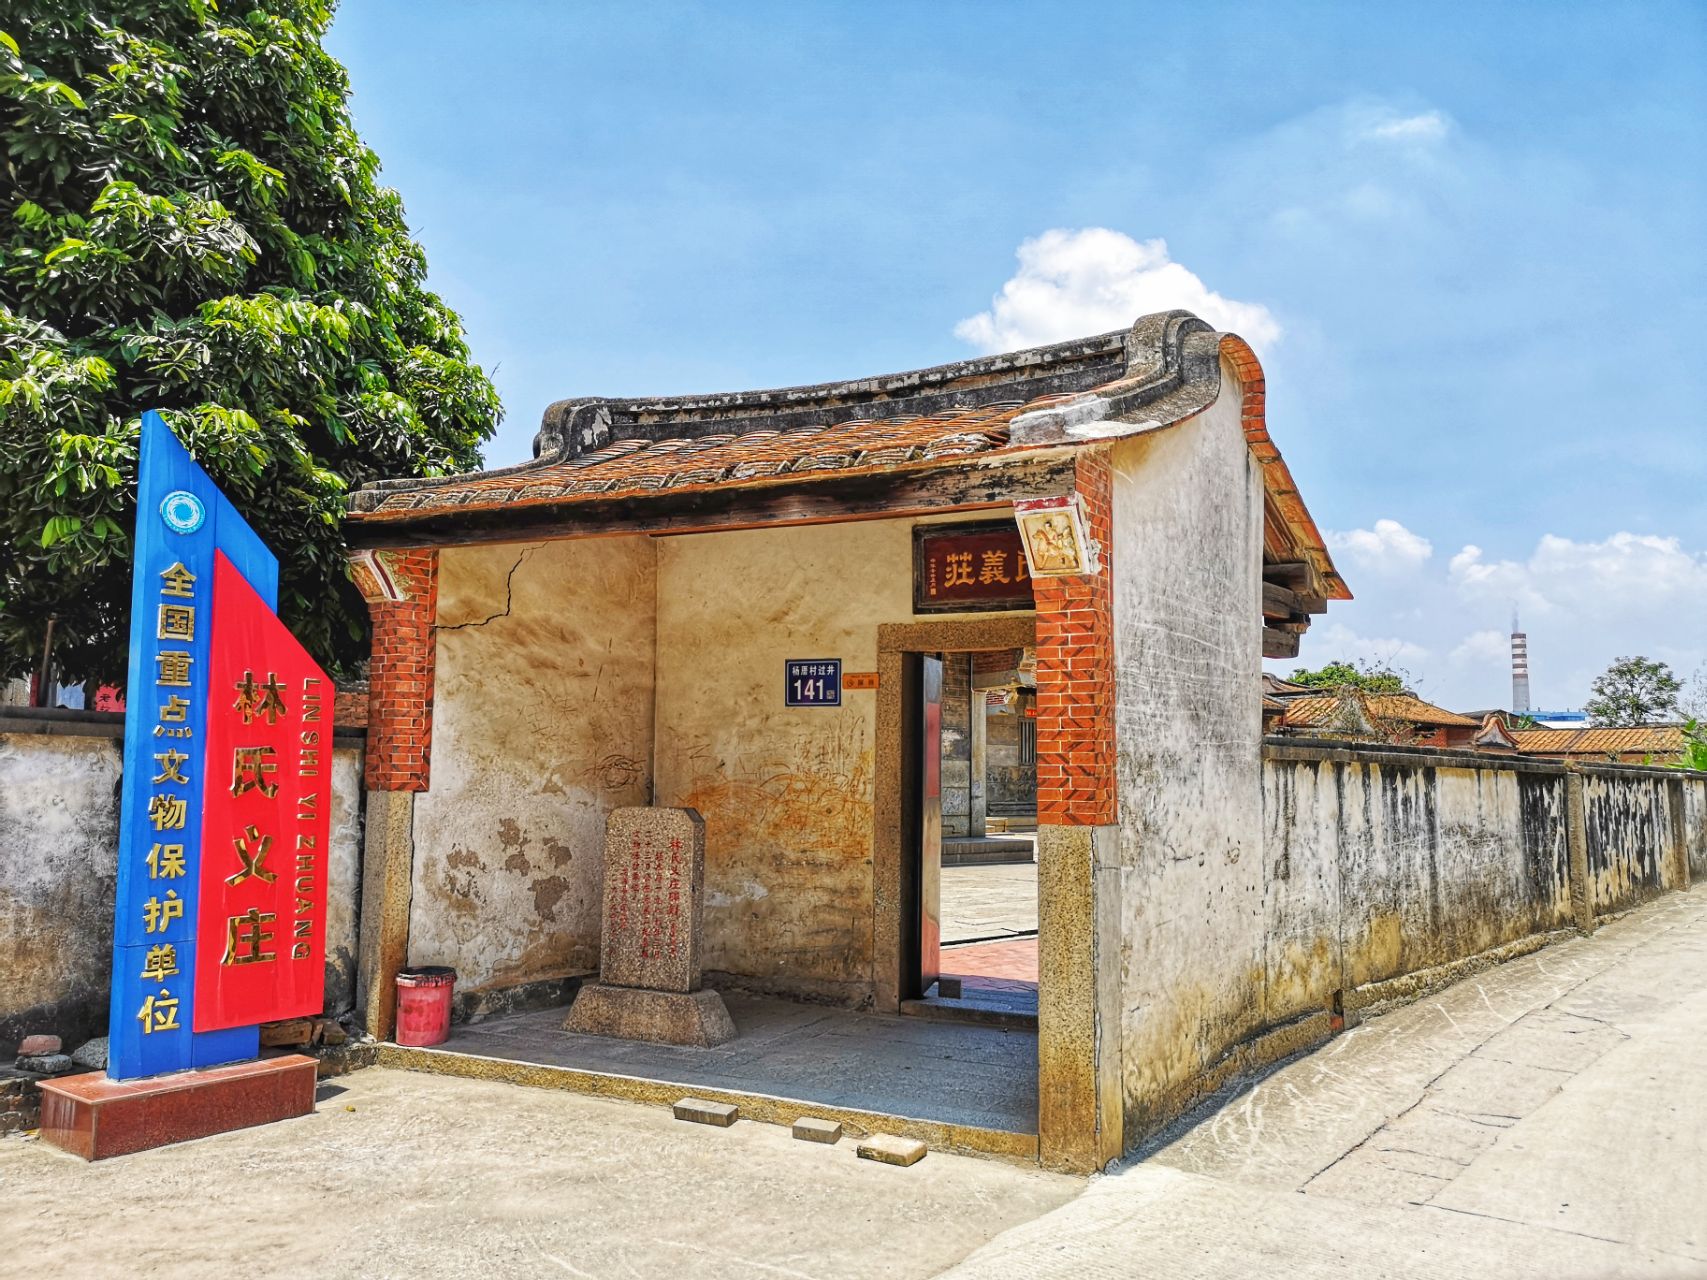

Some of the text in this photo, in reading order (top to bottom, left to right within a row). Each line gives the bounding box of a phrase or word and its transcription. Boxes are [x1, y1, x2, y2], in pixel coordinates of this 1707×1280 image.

[794, 679, 824, 700] 141
[137, 561, 197, 1035] 全国重点文物保护单位
[220, 671, 288, 968] 林氏义庄
[297, 792, 318, 821] YI
[291, 833, 316, 961] ZHUANG
